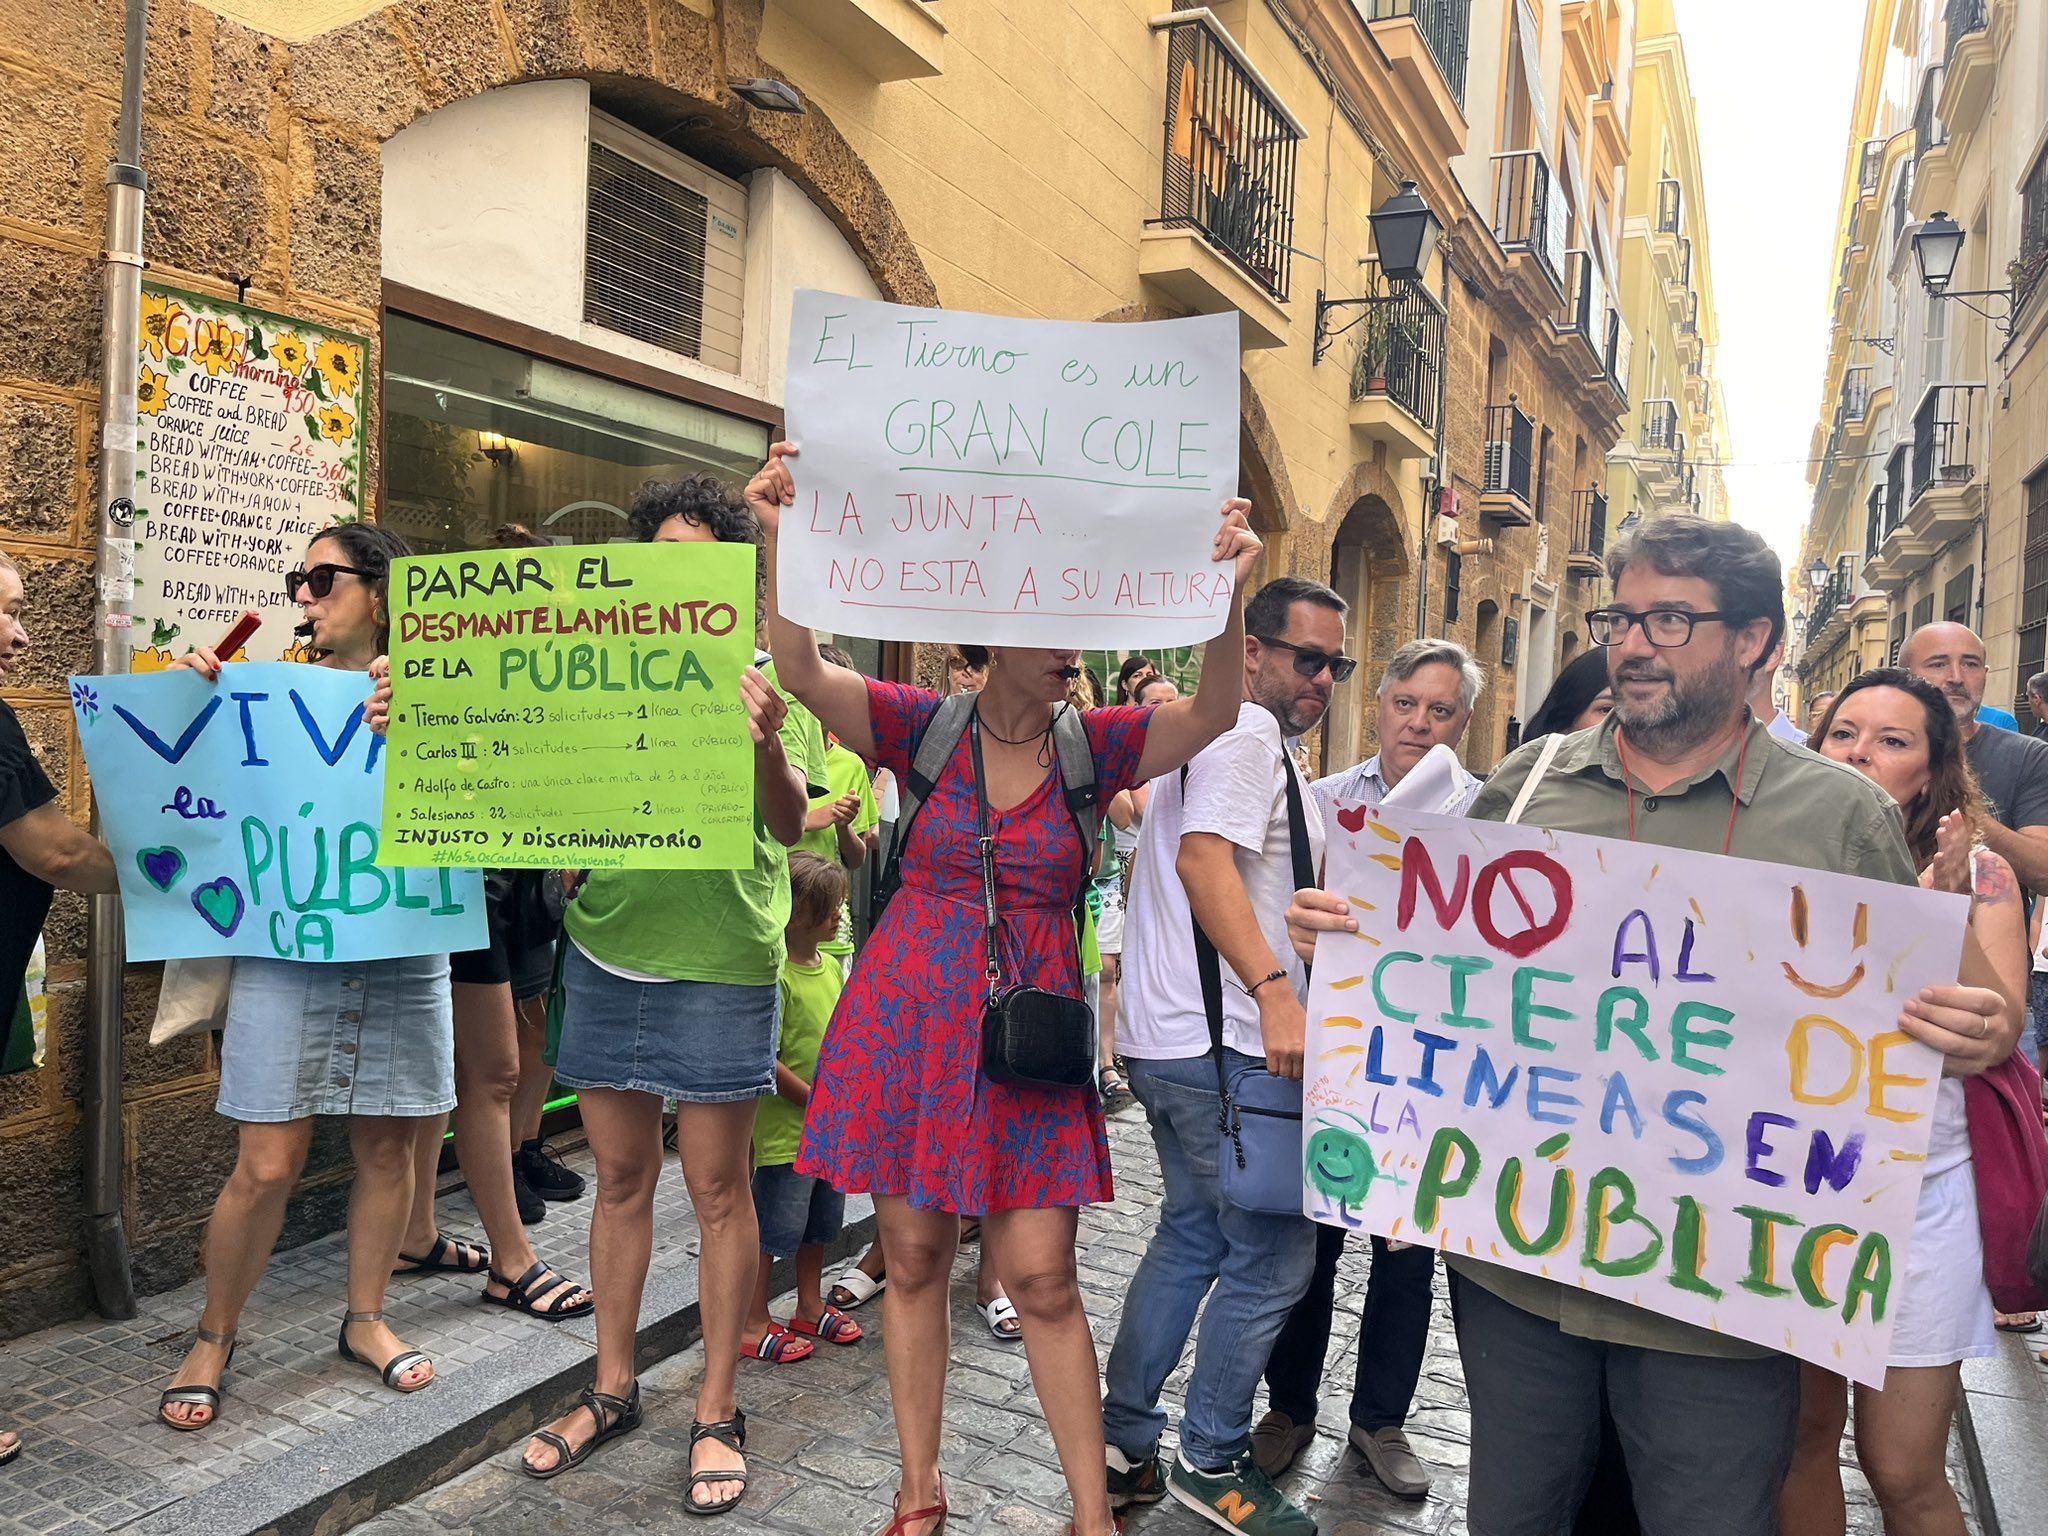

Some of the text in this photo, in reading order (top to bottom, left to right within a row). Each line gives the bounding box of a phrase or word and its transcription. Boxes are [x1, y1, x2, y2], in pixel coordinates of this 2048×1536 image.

[813, 313, 1199, 388] EL Tierno es un
[189, 373, 248, 401] COFFEE
[157, 415, 204, 437] ORANGE
[209, 423, 250, 445] JUICE
[167, 393, 287, 432] COFFEE and BREAD
[150, 432, 194, 457] BREAD
[885, 399, 1209, 479] GRAN COLE
[151, 454, 199, 479] BREAD
[151, 476, 197, 500] BREAD
[146, 521, 197, 544] BREAD
[810, 490, 863, 536] LA
[892, 493, 1042, 535] JUNTA
[163, 580, 211, 603] BREAD
[408, 556, 633, 606] PARAR EL
[829, 541, 1232, 610] NO ESTÁ A SU ALTURA
[400, 600, 738, 643] DESMANTELAMIENTO
[404, 641, 714, 692] DE LA PÚBLICA
[411, 704, 459, 727] Tierno
[523, 706, 545, 724] 23
[549, 708, 615, 722] solicitudes
[637, 704, 648, 719] 1
[651, 702, 681, 717] línea
[416, 742, 457, 760] Carlos
[492, 740, 509, 757] 24
[512, 740, 578, 756] solicitudes
[636, 732, 648, 751] 1
[651, 737, 677, 748] línea
[414, 777, 457, 800] Adolfo
[460, 778, 474, 791] de
[520, 779, 540, 788] una
[576, 772, 604, 785] clase
[609, 770, 643, 783] mixta
[649, 770, 661, 781] de
[489, 807, 507, 820] 22
[509, 805, 563, 819] solicitudes
[642, 800, 652, 815] 2
[395, 829, 489, 846] INJUSTO
[522, 825, 701, 849] DISCRIMINATORIO
[1397, 836, 1717, 988] NO AL
[1372, 951, 1929, 1122] CIERE DE
[1365, 1025, 1866, 1195] LINEAS EN
[1370, 1091, 1422, 1141] LA
[1413, 1126, 1892, 1326] PÚBLICA
